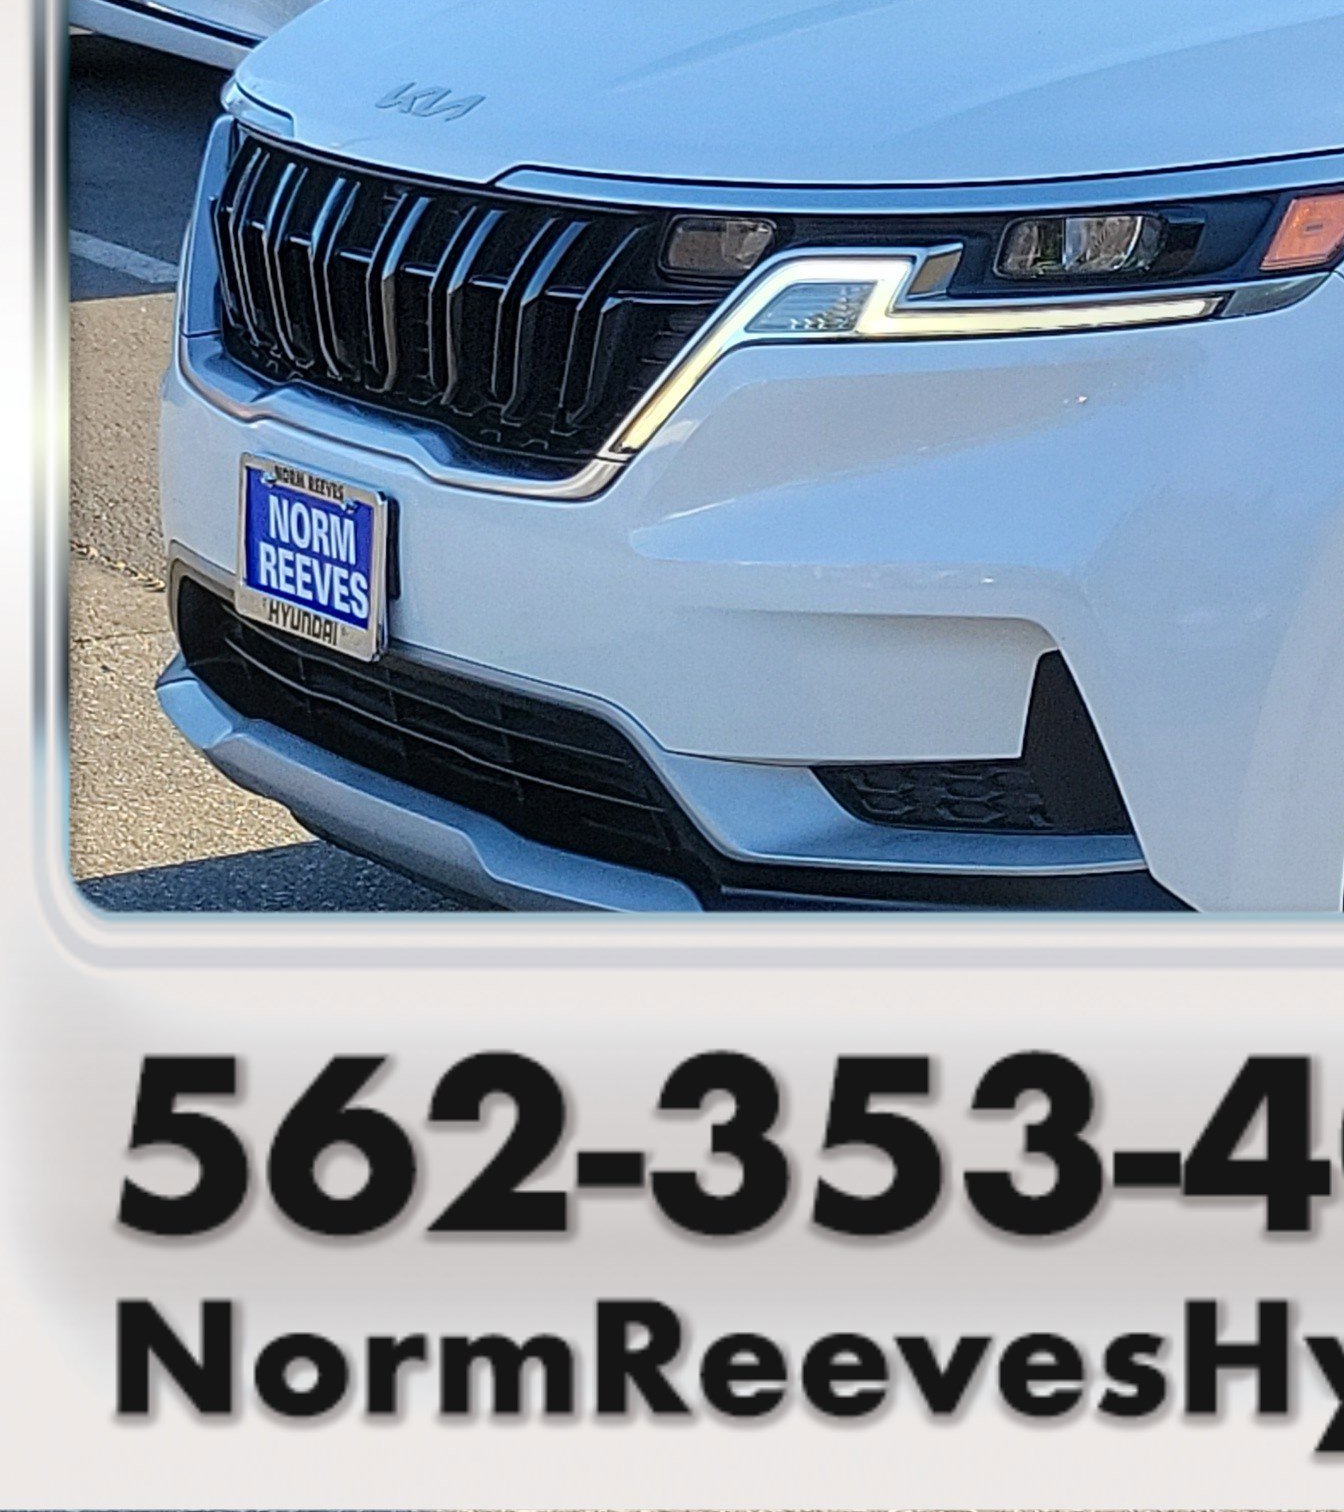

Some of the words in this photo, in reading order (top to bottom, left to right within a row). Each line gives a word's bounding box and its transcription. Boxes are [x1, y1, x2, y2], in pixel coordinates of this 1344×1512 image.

[308, 475, 344, 502] REEVES
[268, 494, 357, 566] NORM
[259, 541, 370, 620] REEVES
[268, 599, 338, 646] HYUNDAI
